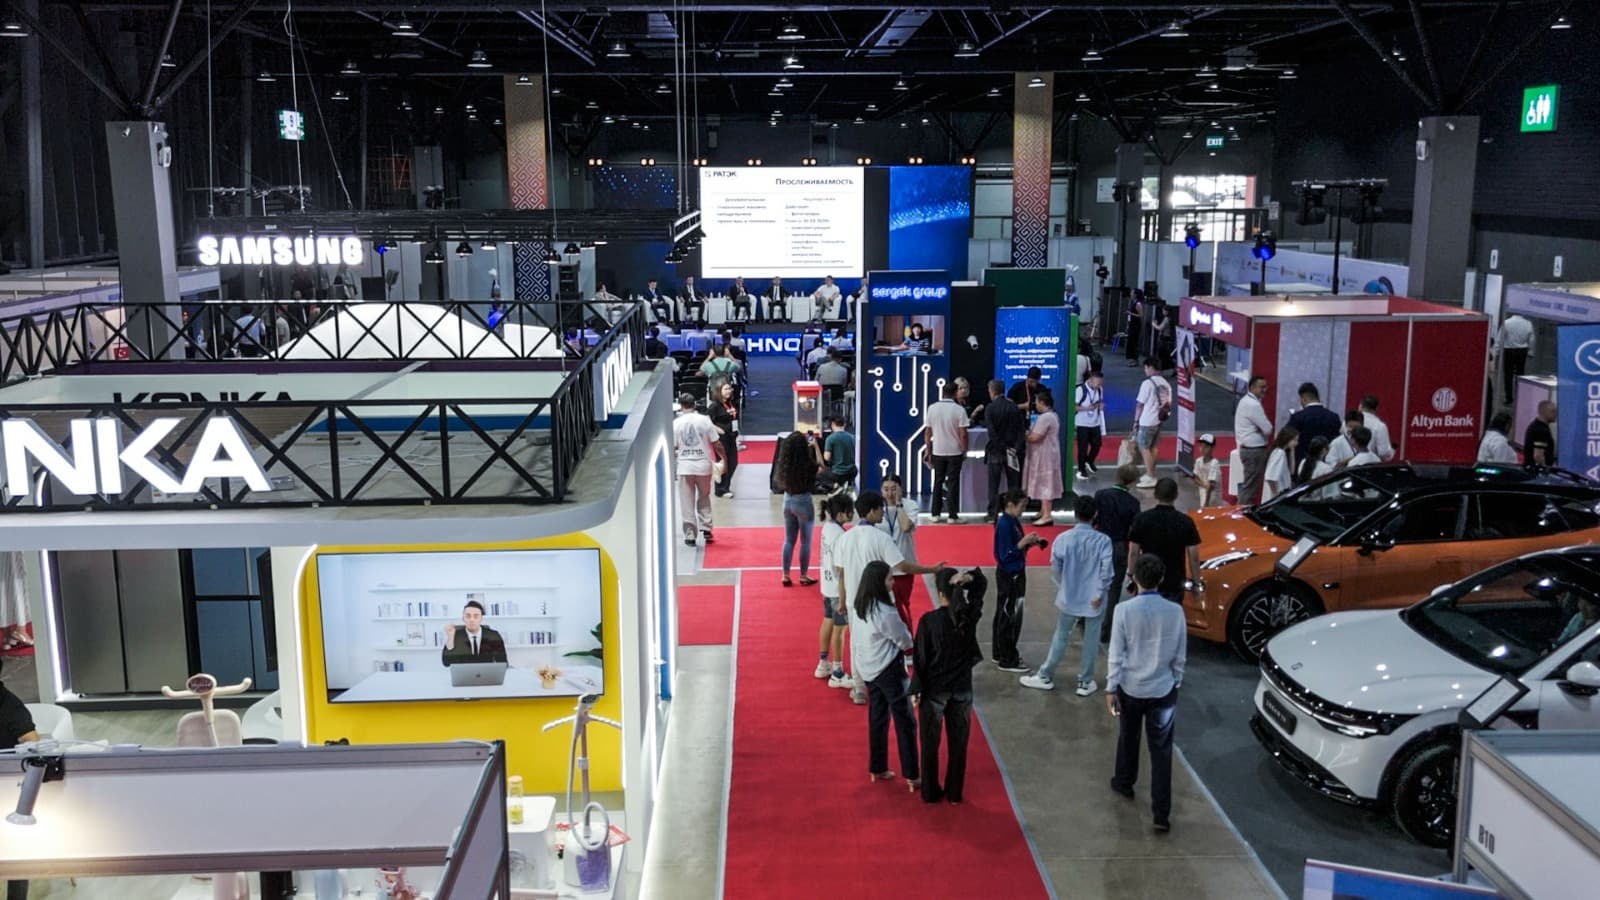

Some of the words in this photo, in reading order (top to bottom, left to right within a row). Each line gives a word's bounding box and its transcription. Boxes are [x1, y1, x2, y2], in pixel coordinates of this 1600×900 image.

[1206, 137, 1223, 146] EXIT
[197, 235, 363, 266] SAMSUNG
[872, 286, 912, 299] sergek
[913, 287, 948, 299] group
[1005, 335, 1033, 345] sergek
[1034, 336, 1060, 345] group
[1411, 414, 1442, 431] Altyn
[1444, 414, 1474, 427] Bank
[1478, 824, 1495, 855] B10
